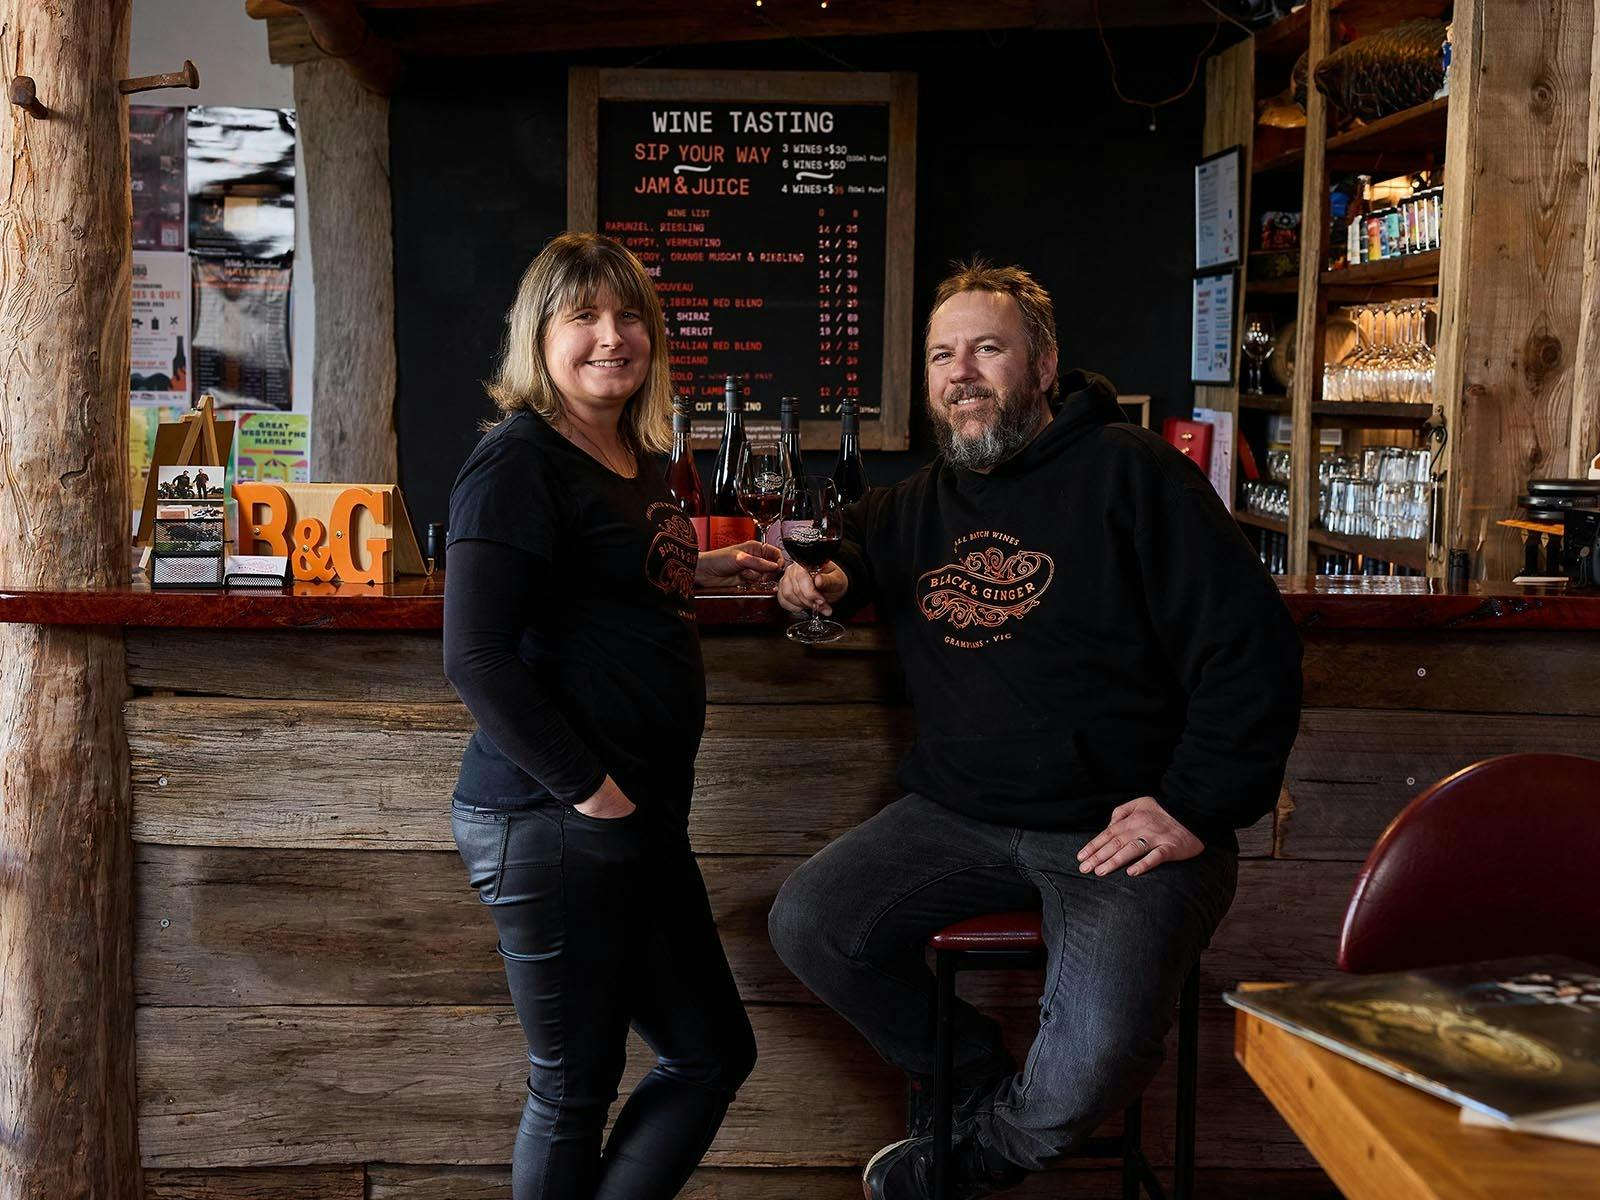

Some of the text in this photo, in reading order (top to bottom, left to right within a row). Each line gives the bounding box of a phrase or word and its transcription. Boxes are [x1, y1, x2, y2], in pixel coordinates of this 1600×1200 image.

[652, 111, 834, 133] WINE TASTING
[782, 143, 789, 153] 3
[634, 143, 771, 164] SIP YOUR WAY
[782, 159, 789, 169] 6
[634, 176, 750, 196] JAM & JUICE
[781, 184, 788, 193] 4
[667, 209, 711, 218] WINE LIST
[660, 222, 705, 232] RIESLING
[665, 238, 721, 248] VERMENTINO
[670, 252, 704, 262] ORANGE
[709, 252, 742, 262] MUSCAT
[747, 252, 756, 263] &
[759, 252, 805, 264] RIESLING
[655, 282, 693, 292] NOUVEAU
[713, 298, 730, 308] RED
[735, 298, 763, 308] BLEND
[676, 312, 710, 322] SHIRAZ
[680, 327, 714, 337] MERLOT
[669, 341, 763, 351] ITALIAN RED BLEND
[668, 356, 709, 366] RACIANO
[680, 387, 751, 396] NAT LAMBO
[695, 401, 713, 412] CUT
[258, 422, 290, 430] GREAT
[255, 438, 293, 446] MARKET
[969, 530, 990, 541] BATCH
[992, 531, 1020, 547] WINES
[930, 573, 1036, 601] BLACK & GINGER
[993, 633, 1012, 642] VIC
